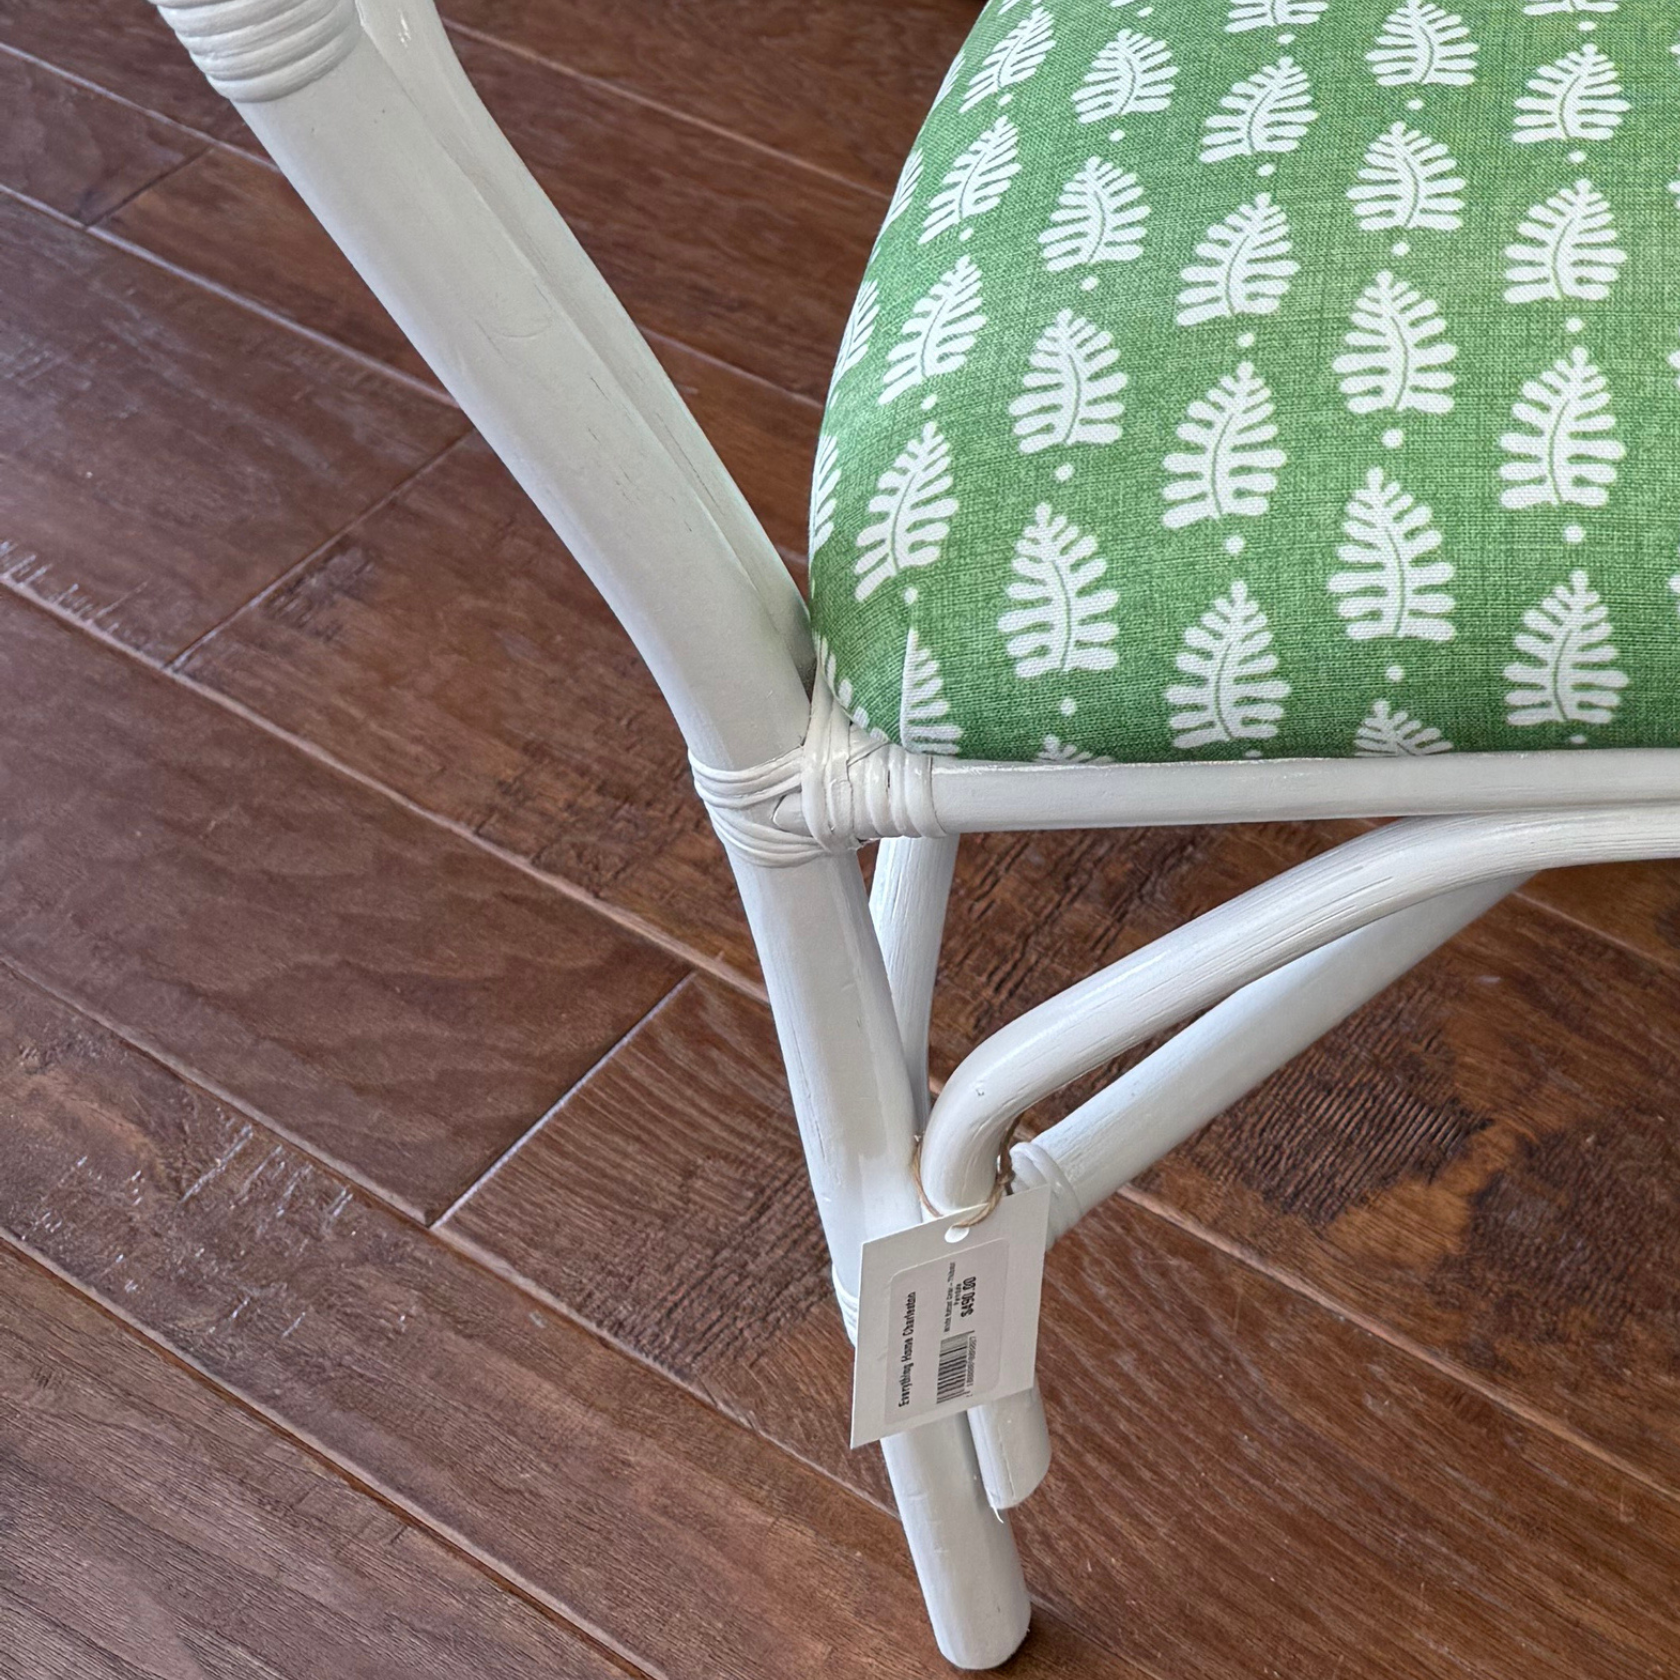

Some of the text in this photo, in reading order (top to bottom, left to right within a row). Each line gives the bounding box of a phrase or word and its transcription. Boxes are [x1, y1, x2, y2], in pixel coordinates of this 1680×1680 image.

[961, 1276, 976, 1318] $490.00
[898, 1292, 916, 1407] Everything Home Charleston
